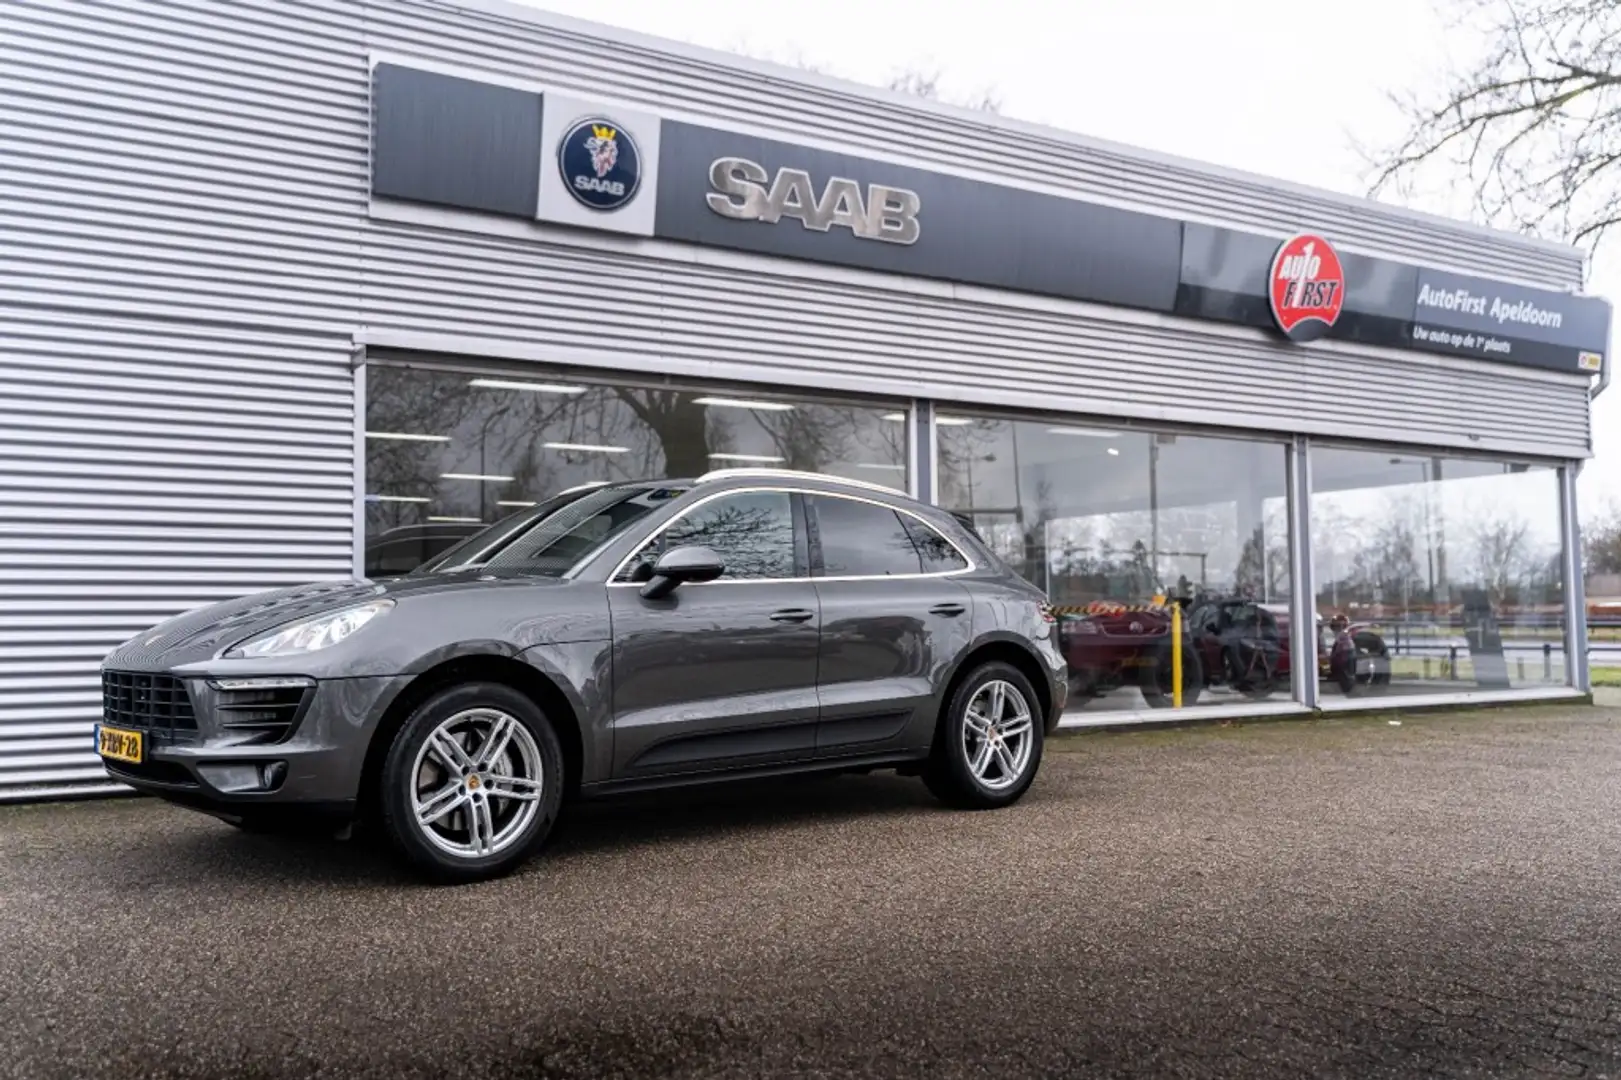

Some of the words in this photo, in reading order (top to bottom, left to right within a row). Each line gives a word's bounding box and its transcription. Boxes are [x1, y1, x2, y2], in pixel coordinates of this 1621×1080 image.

[574, 174, 625, 197] SAAB
[706, 156, 921, 245] SAAB
[1417, 284, 1487, 315] AutoFirst
[1490, 296, 1563, 328] Apeldoorn
[1413, 325, 1430, 340] Uw
[1429, 330, 1450, 344] auto
[1450, 334, 1463, 348] op
[1463, 333, 1475, 348] de
